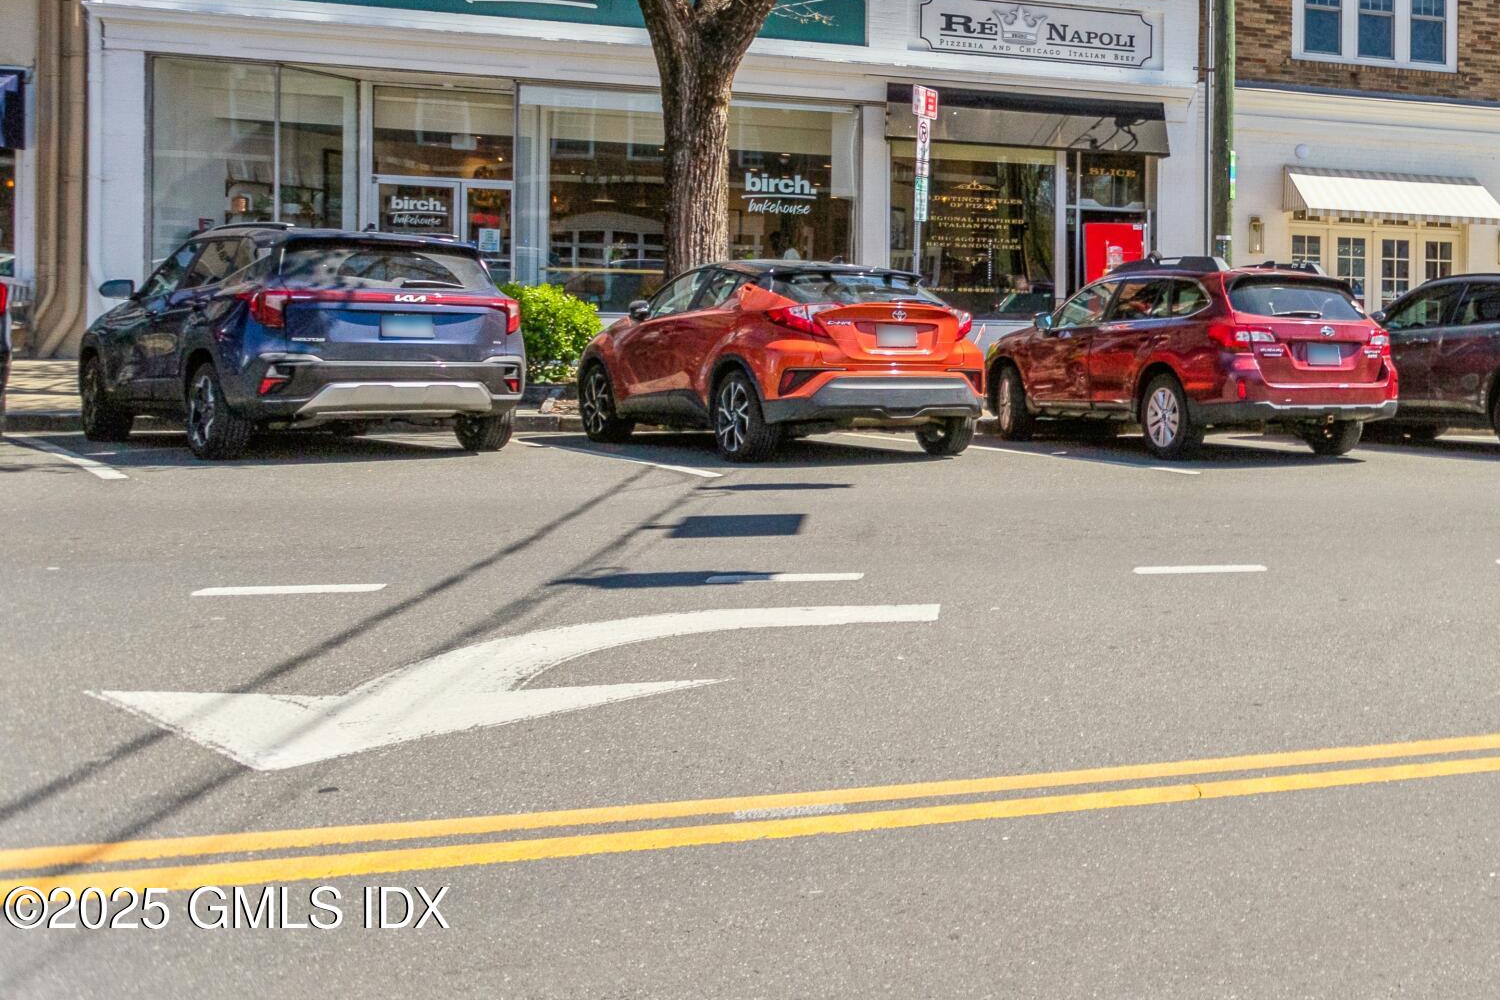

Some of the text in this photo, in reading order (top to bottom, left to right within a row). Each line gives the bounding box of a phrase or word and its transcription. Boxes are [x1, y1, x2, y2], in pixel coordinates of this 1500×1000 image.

[1046, 22, 1136, 48] NAPOLI
[1089, 167, 1137, 177] SLICE
[745, 172, 817, 194] birch.
[391, 195, 448, 212] birch.
[748, 199, 812, 215] bakehouse
